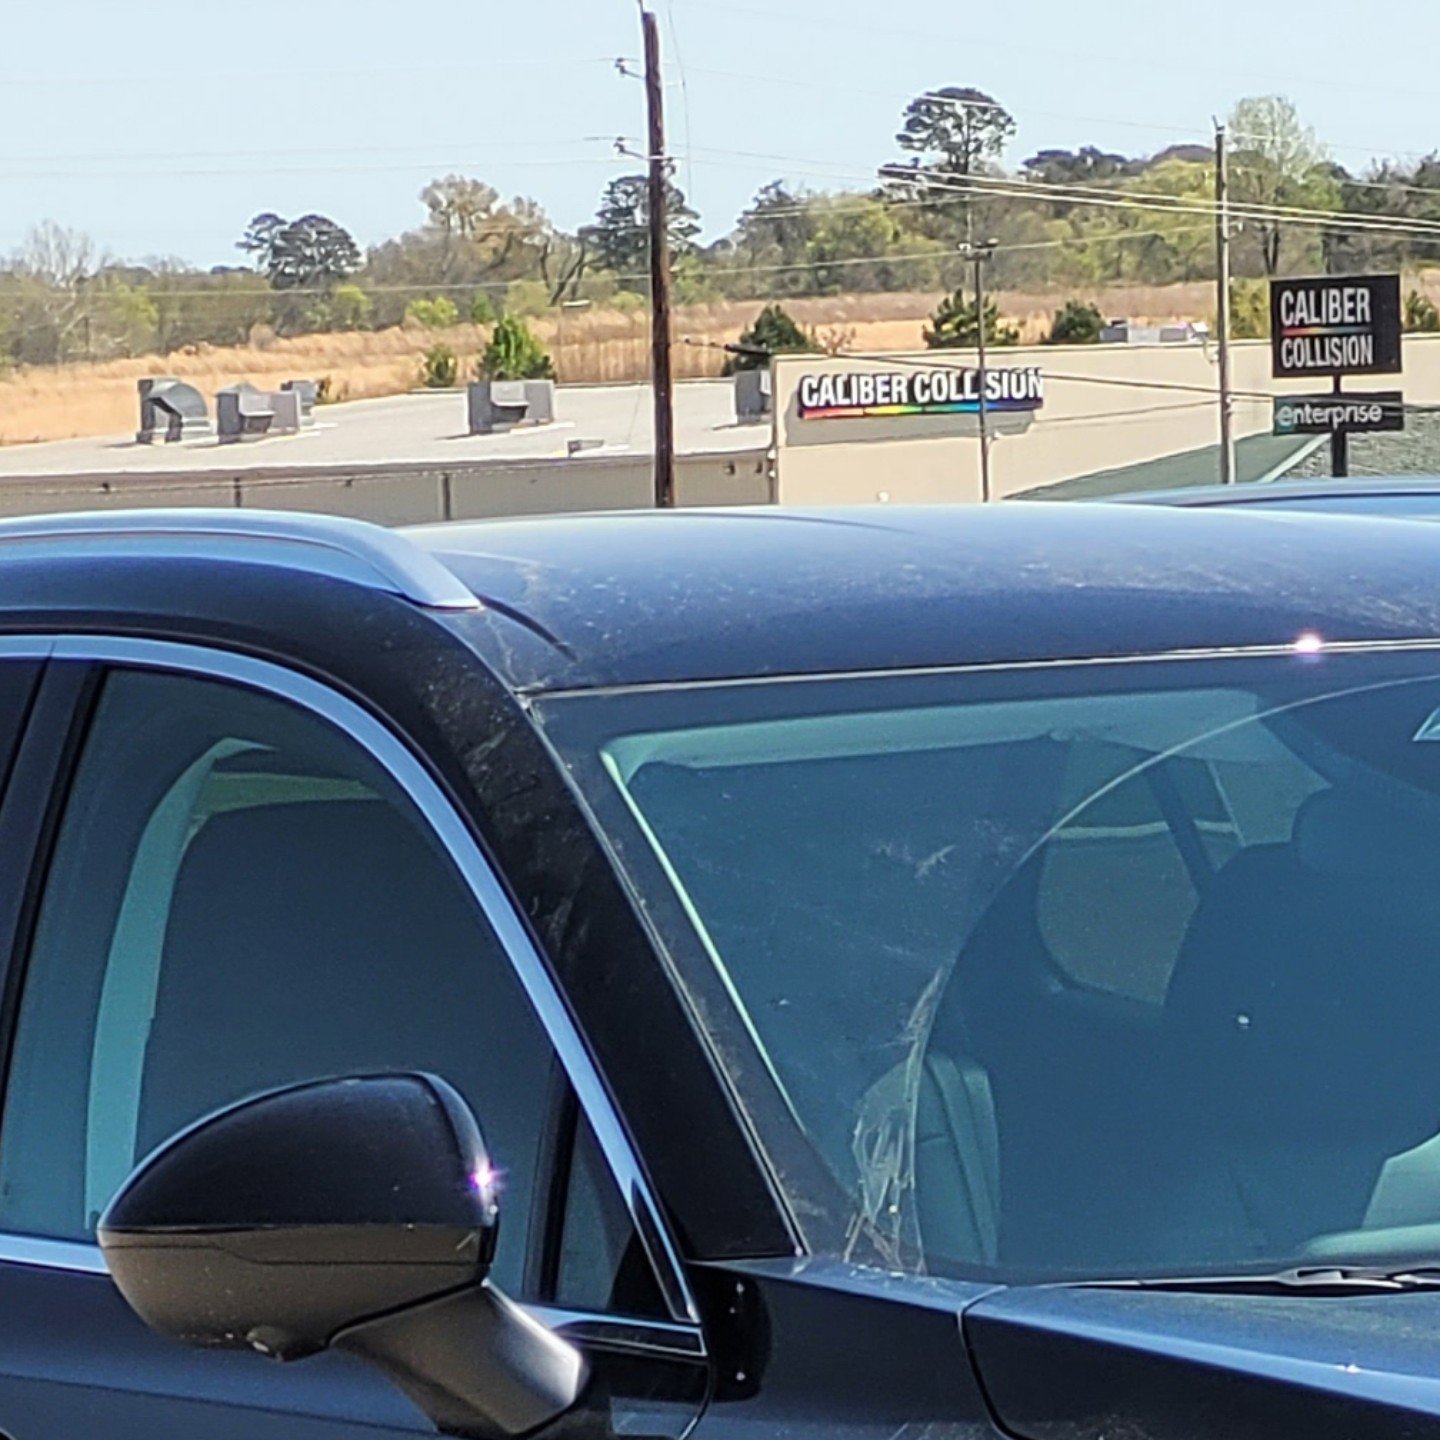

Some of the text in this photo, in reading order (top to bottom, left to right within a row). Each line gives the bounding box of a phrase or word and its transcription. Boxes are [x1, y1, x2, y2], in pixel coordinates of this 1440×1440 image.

[1279, 286, 1371, 326] CALIBER
[1280, 334, 1375, 369] COLLISION
[801, 367, 1045, 407] CALIBER COLLSION
[1276, 403, 1384, 429] enterprise
